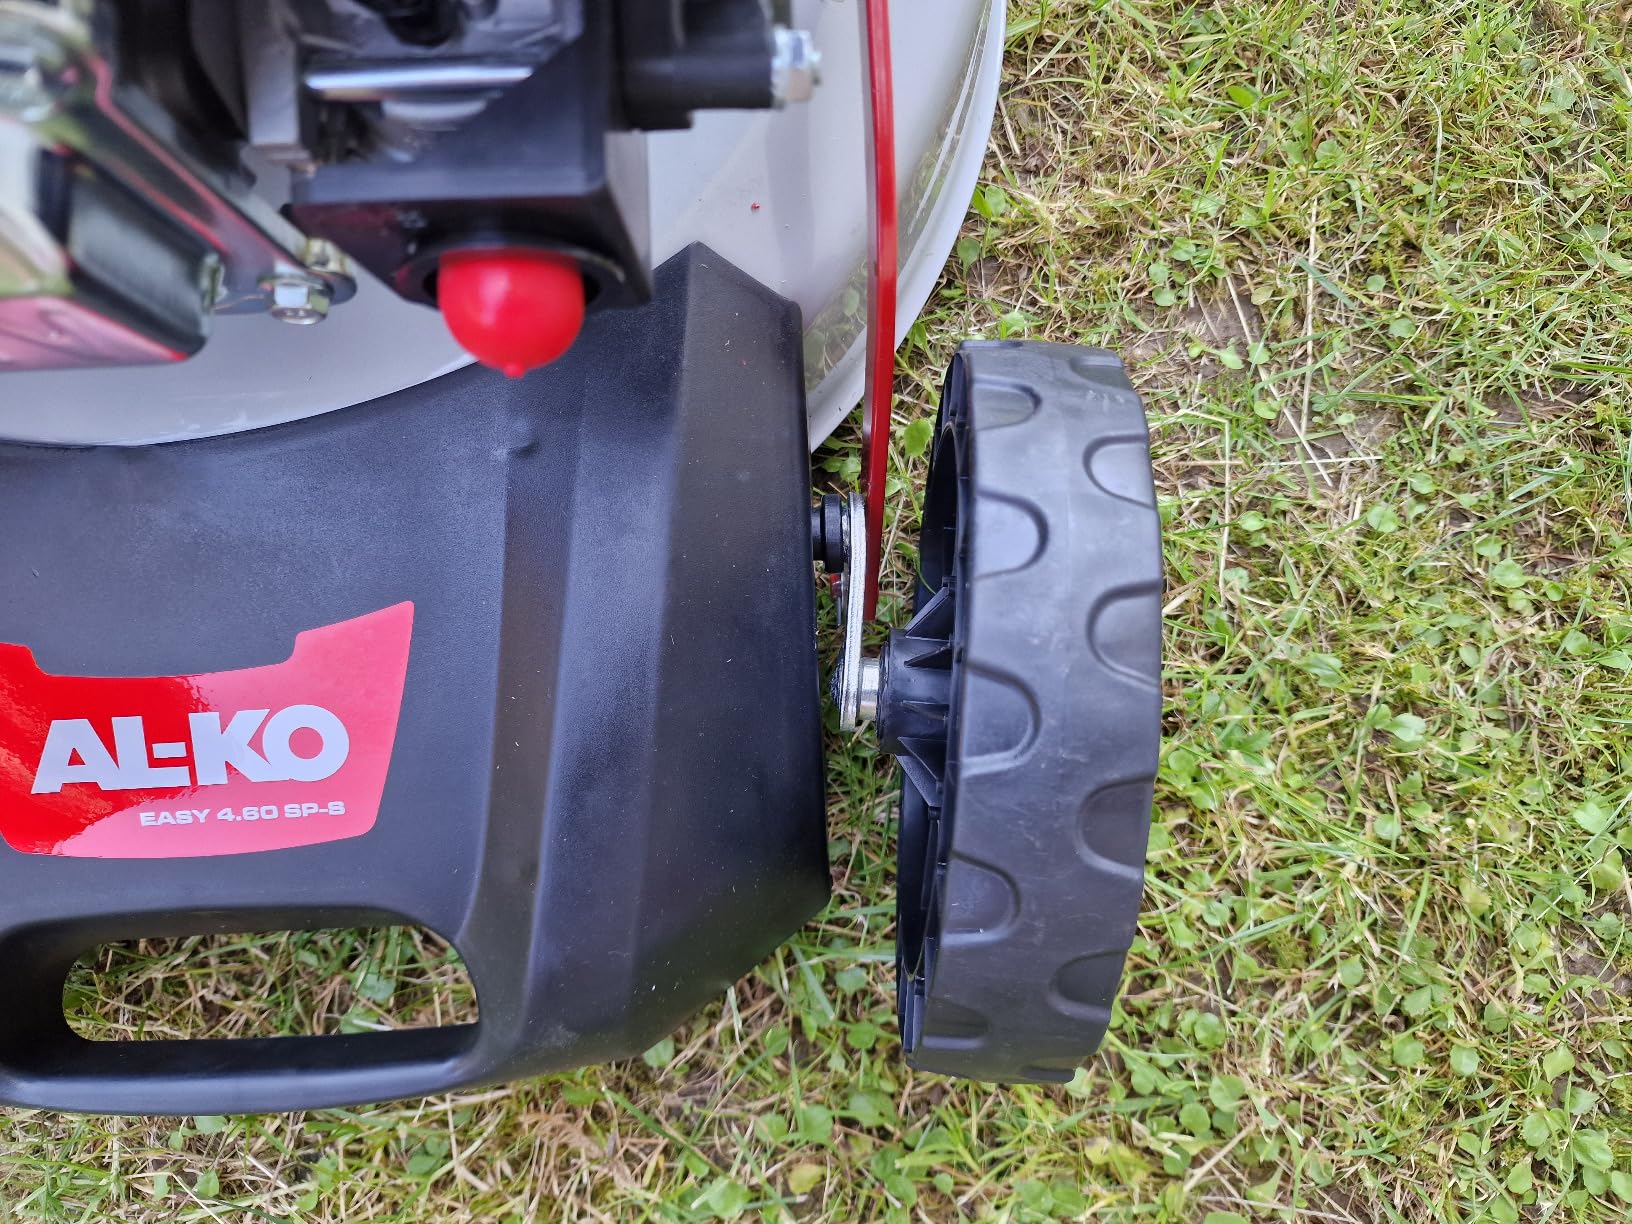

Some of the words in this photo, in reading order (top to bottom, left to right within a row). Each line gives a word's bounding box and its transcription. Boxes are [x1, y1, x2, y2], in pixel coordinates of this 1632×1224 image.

[31, 704, 350, 794] AL-KO
[140, 808, 210, 827] EASY
[217, 805, 278, 822] 4.60
[284, 801, 346, 818] SP-S
